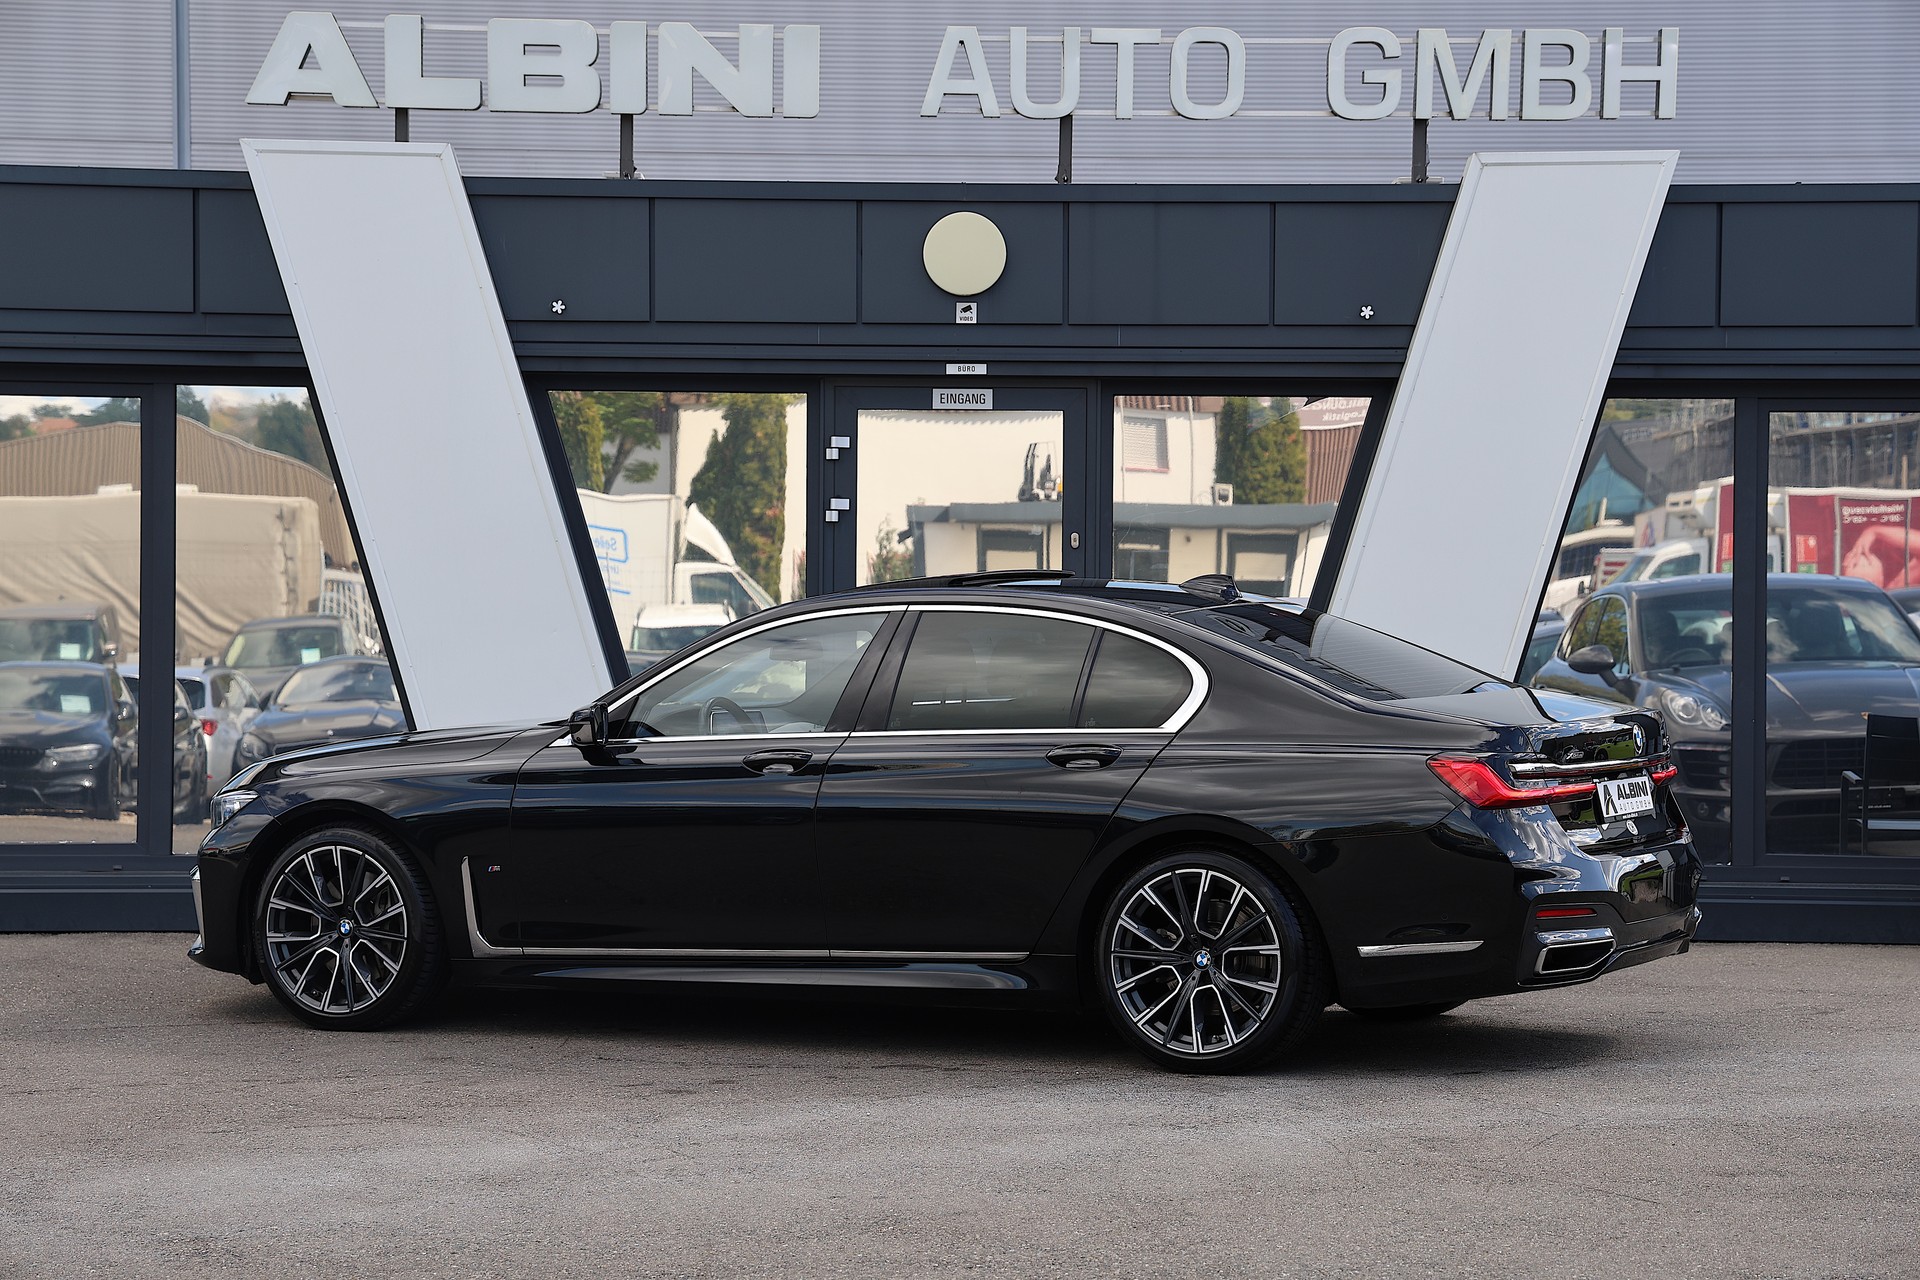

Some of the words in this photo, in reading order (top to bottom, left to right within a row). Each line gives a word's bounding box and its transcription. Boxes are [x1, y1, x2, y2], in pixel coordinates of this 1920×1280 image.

[245, 11, 821, 119] ALBINI
[920, 26, 1246, 121] AUTO
[1326, 27, 1679, 122] GMBH
[939, 393, 986, 405] EINGANG
[1617, 780, 1648, 800] ALBINI
[1619, 801, 1634, 811] AUTO
